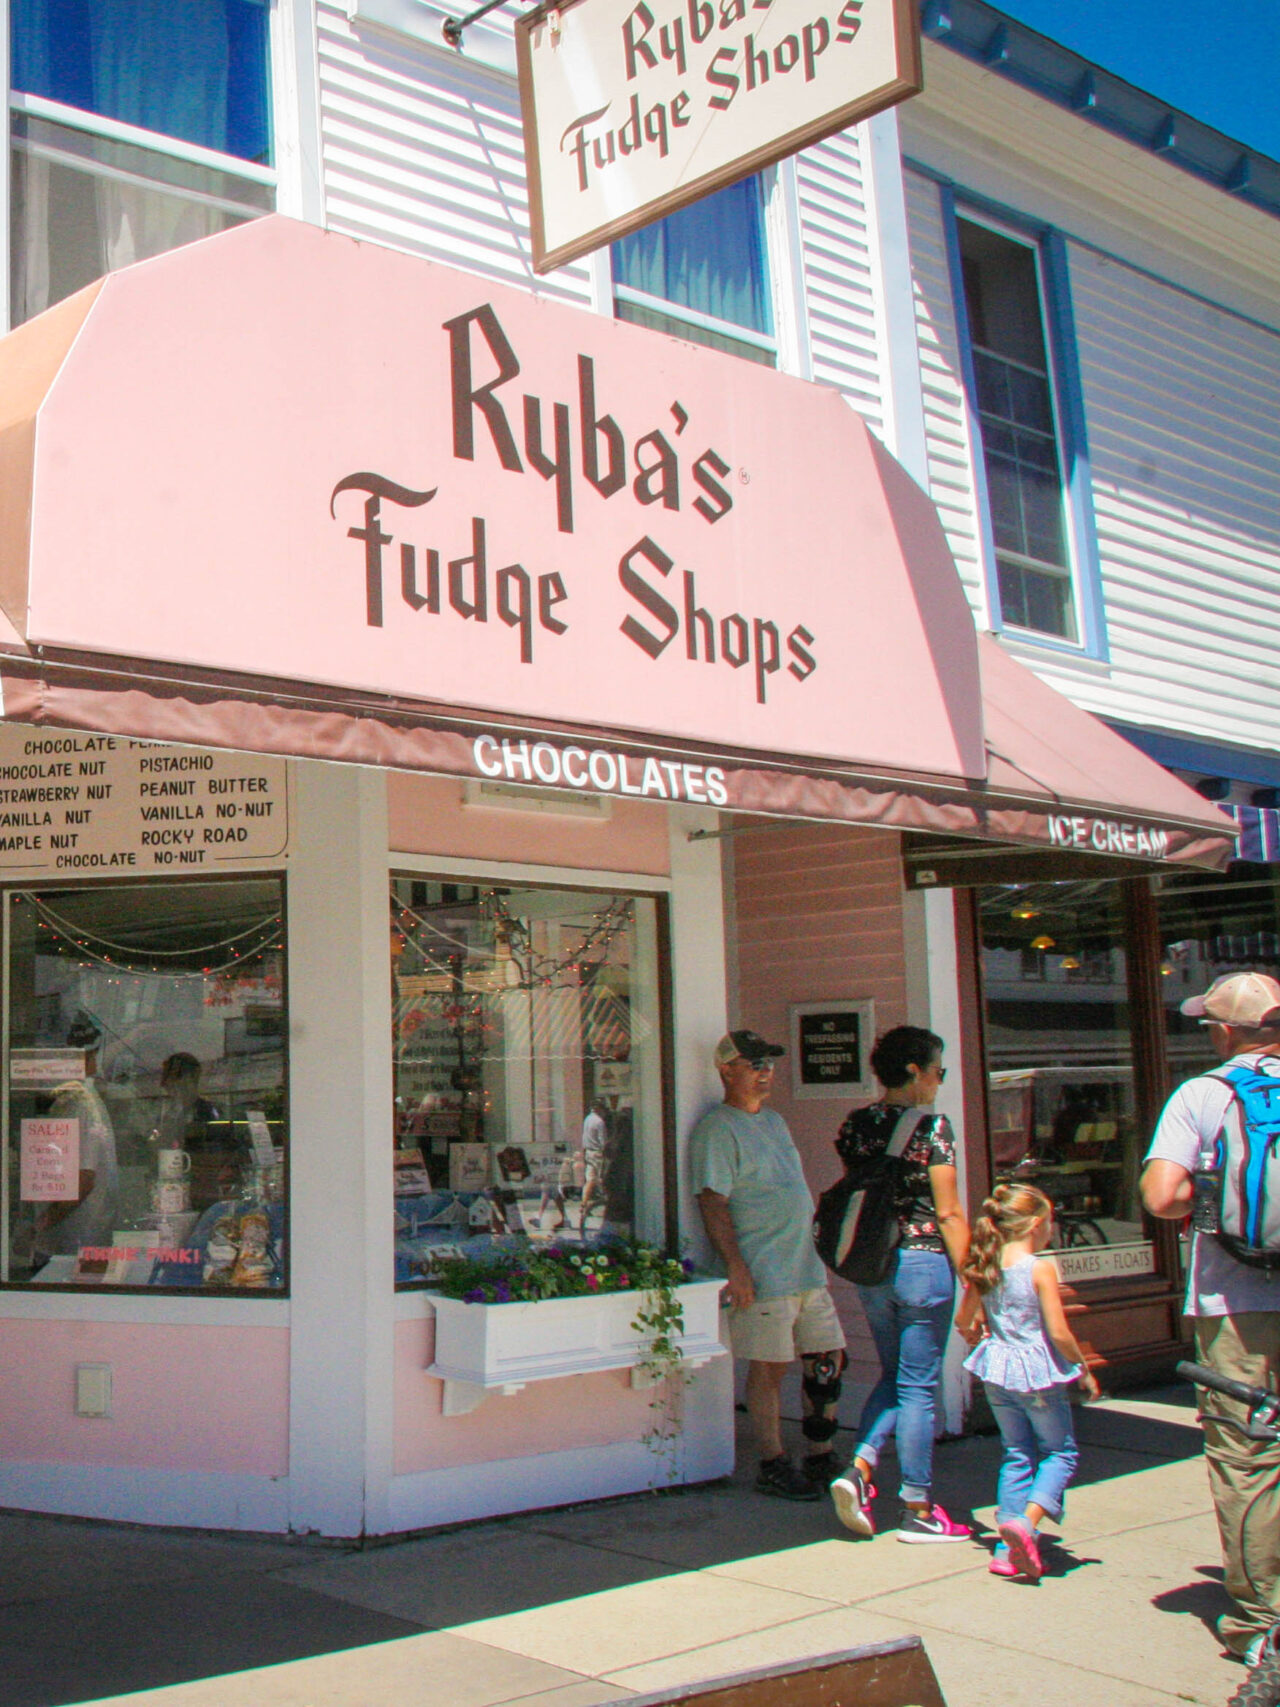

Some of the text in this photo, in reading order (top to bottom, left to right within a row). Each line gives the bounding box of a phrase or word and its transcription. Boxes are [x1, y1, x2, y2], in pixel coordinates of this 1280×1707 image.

[560, 1, 864, 192] Fudge Shops
[442, 303, 733, 533] Ryba's
[330, 472, 816, 705] Fudge Shops
[24, 737, 117, 755] CHOCOLATE
[79, 761, 107, 776] NUT
[140, 755, 214, 773] PISTACHIO
[473, 734, 728, 805] CHOCOLATES
[87, 784, 113, 800] NUT
[140, 778, 268, 797] PEANUT BUTTER
[65, 810, 92, 825] NUT
[140, 802, 274, 821] VANILLA NO-NUT
[50, 834, 79, 850] NUT
[141, 828, 248, 846] ROCKY ROAD
[1048, 814, 1169, 859] ICE CREAM
[56, 850, 206, 869] CHOCOLATE NO-NUT
[807, 1052, 852, 1063] RESIDENTS
[820, 1065, 841, 1075] ONLY
[28, 1123, 69, 1136] SALE!
[1061, 1251, 1150, 1275] SHAKES FLOATS
